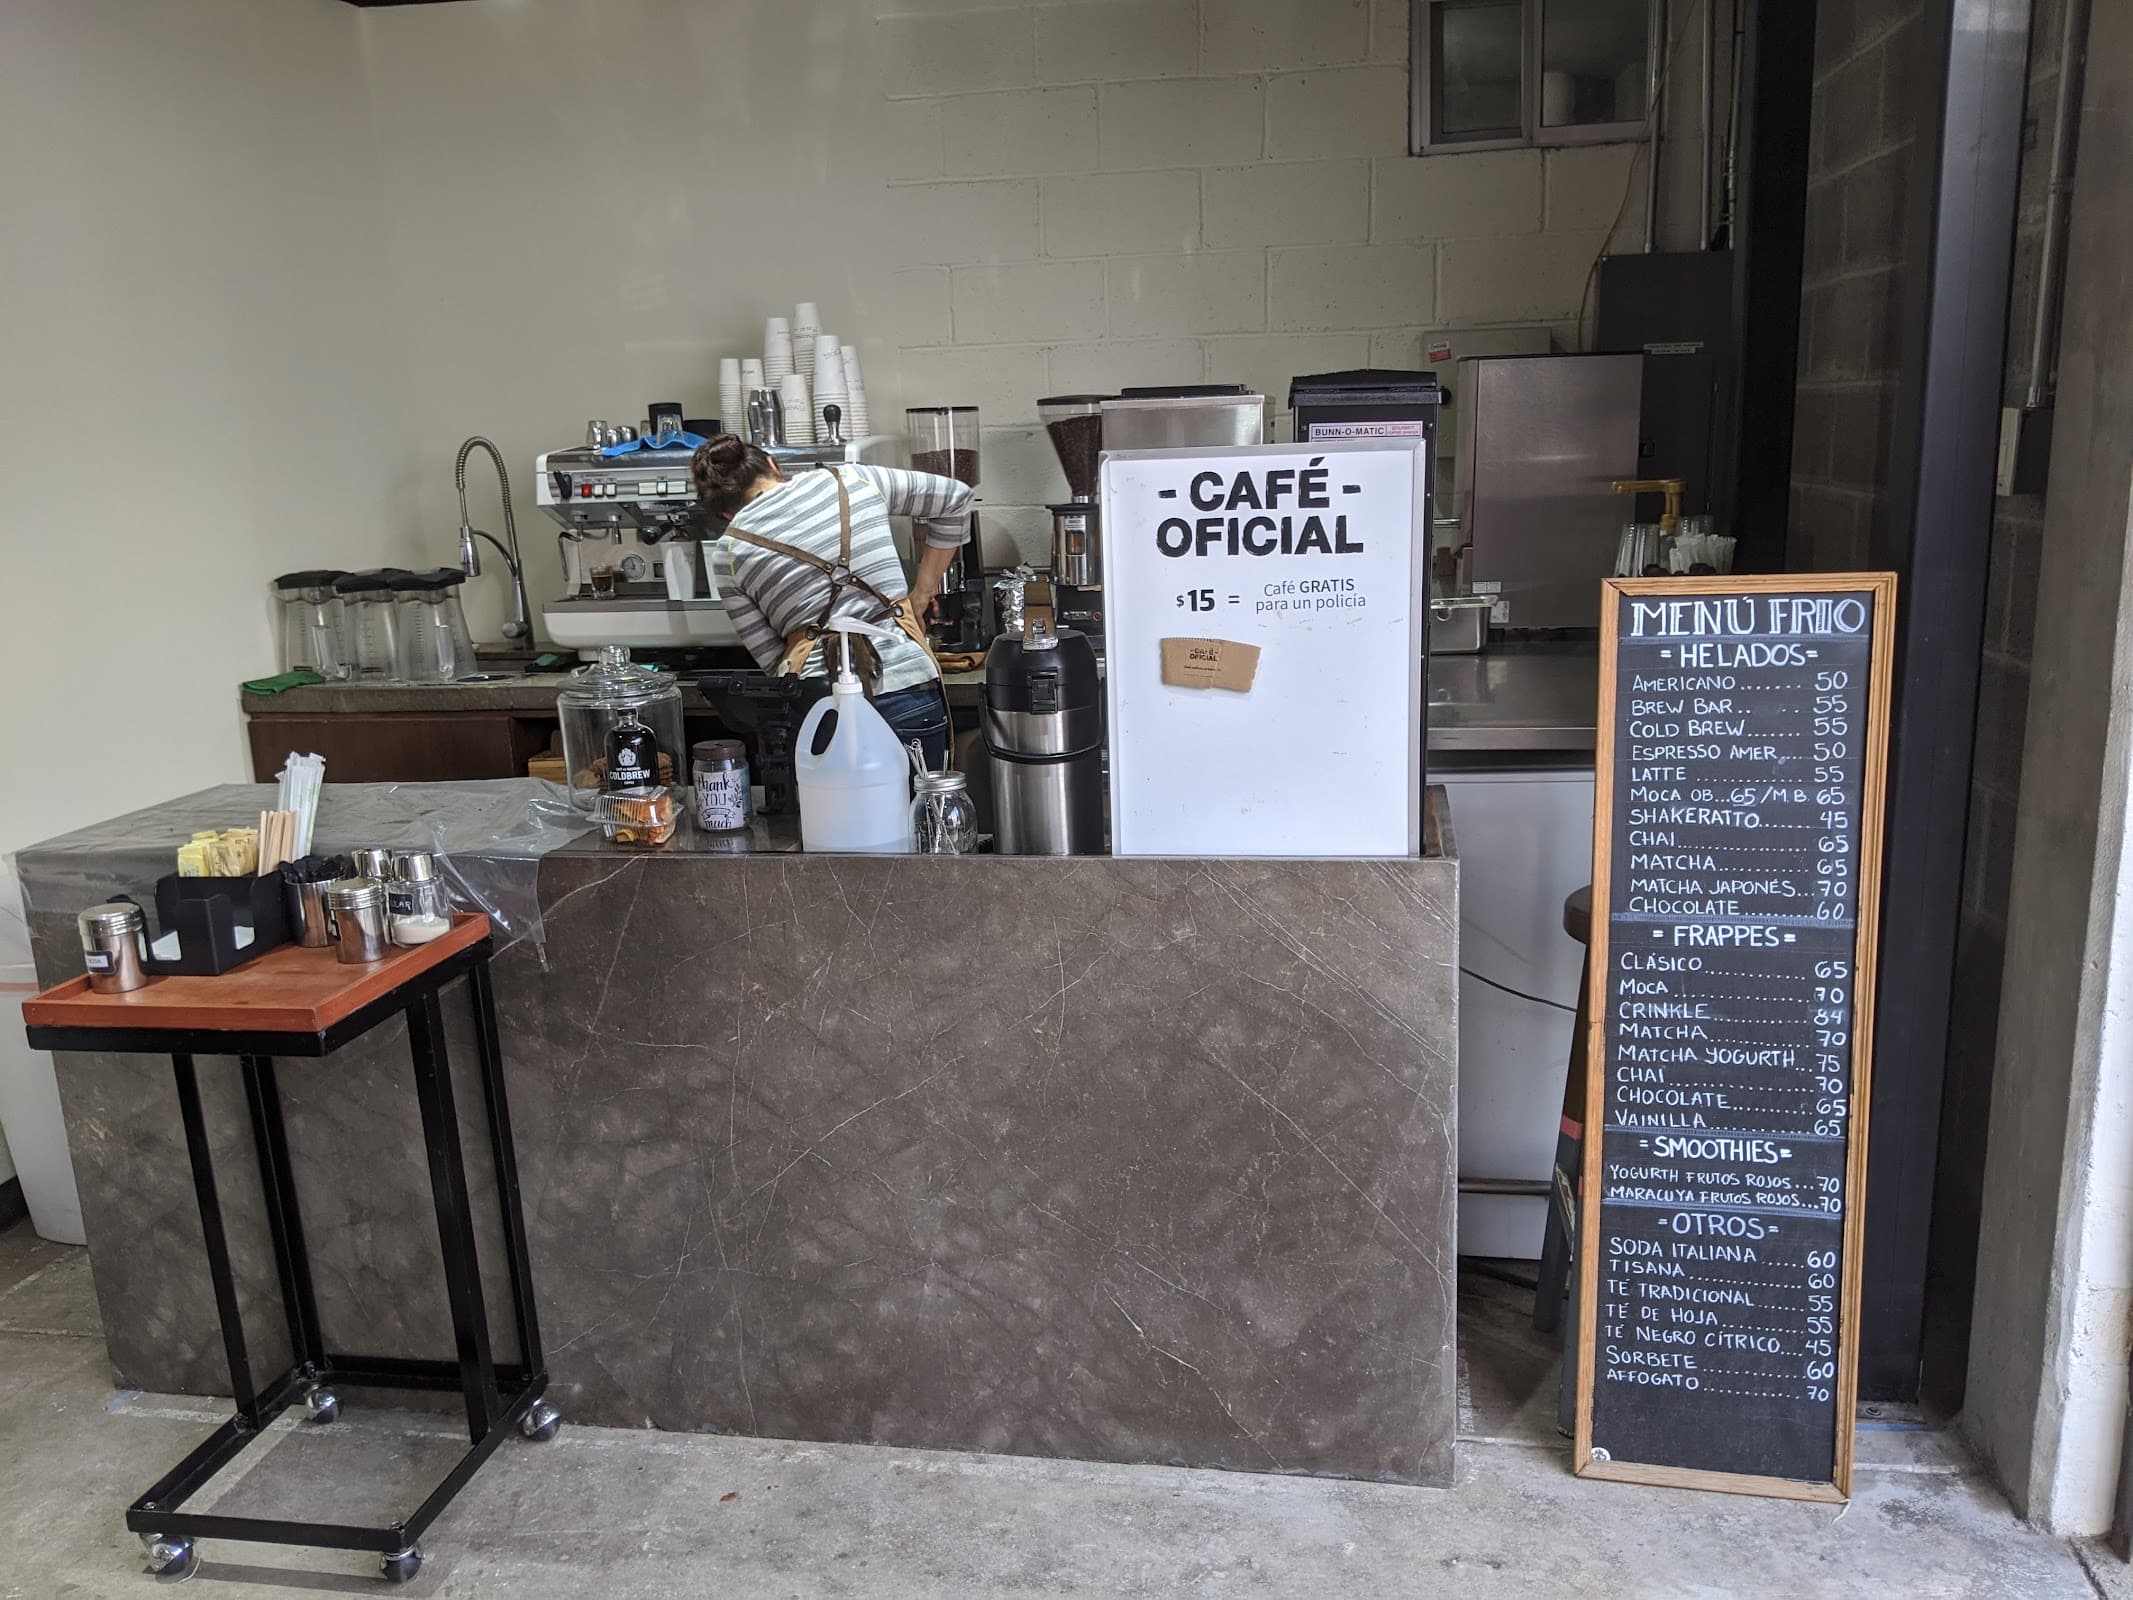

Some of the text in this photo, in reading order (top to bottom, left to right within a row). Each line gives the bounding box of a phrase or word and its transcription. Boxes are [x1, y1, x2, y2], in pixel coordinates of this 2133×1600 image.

[1314, 426, 1386, 437] BUNN-O-MATIC
[1190, 457, 1331, 512] CAFÉ
[1156, 514, 1364, 558] OFICIAL
[1264, 581, 1296, 597] Café
[1299, 578, 1355, 593] GRATIS
[1256, 593, 1366, 614] para un policía
[1630, 596, 1755, 637] MENÚ
[1632, 671, 1848, 691] AMERICANO 50
[1631, 695, 1848, 716] BREW BAR 55
[1629, 717, 1848, 738] COLD BREW 55
[1632, 744, 1721, 761] ESPRESSO
[1813, 741, 1846, 761] 50
[1631, 766, 1844, 783] LATTE 55
[1630, 786, 1682, 802] MOCA
[1730, 788, 1757, 805] 65
[1816, 786, 1845, 805] 65
[1629, 807, 1849, 829] SHAKERATTO 45
[1629, 830, 1849, 853] CHAI 65
[1630, 854, 1848, 877] MATCHA 65
[1630, 878, 1847, 897] MATCHA JAPONÉS 70
[1629, 896, 1845, 920] CHOCOLATE 60
[1673, 924, 1780, 947] FRAPPES
[1814, 961, 1848, 979] 65
[1619, 978, 1844, 1004] MOCA 70
[1619, 1002, 1843, 1026] CRINKLE 84
[1619, 1023, 1847, 1047] MATCHA 70
[1617, 1044, 1841, 1073] MATCHA YOGURTH 75
[1616, 1066, 1843, 1094] CHAI 70
[1616, 1085, 1847, 1117] CHOCOLATE 65
[1614, 1108, 1841, 1137] VAINILLA 65
[1653, 1135, 1779, 1164] SMOOTHIES
[1609, 1164, 1840, 1193] YOGURTH FRUTOS ROJOS 70
[1609, 1186, 1842, 1213] MARACUYA FRUTOS ROJOS 70
[1671, 1212, 1766, 1240] OTROS
[1609, 1236, 1837, 1269] SODA ITALIANA 60
[1609, 1259, 1836, 1289] TISANA 60
[1607, 1278, 1834, 1312] TÉ TRADICIONAL 55
[1605, 1302, 1833, 1334] TÉ DE HOJA 55
[1605, 1324, 1625, 1339] TÉ
[1636, 1326, 1696, 1345] NEGRO
[1805, 1339, 1832, 1357] 45
[1606, 1345, 1834, 1380] SORBETE 60
[1606, 1368, 1829, 1402] AFFOGATO 70
